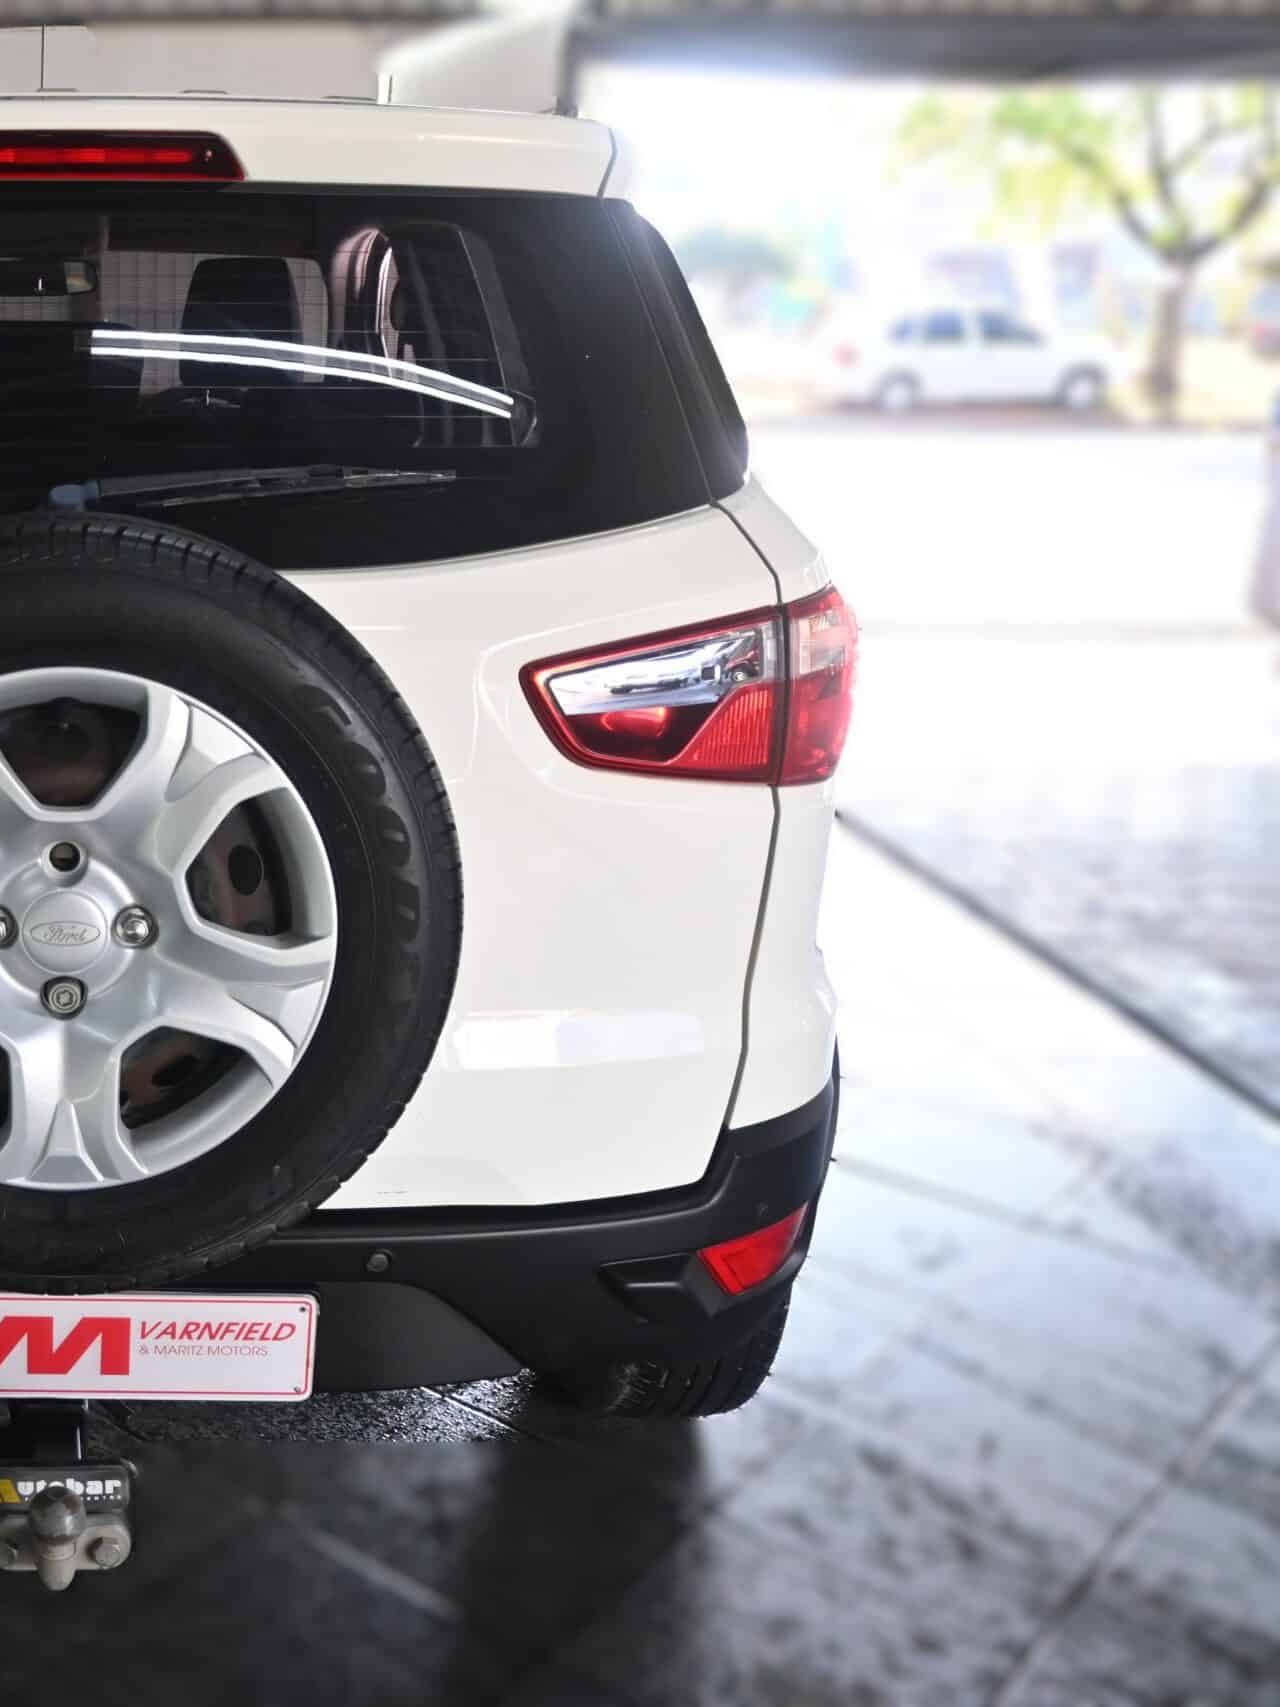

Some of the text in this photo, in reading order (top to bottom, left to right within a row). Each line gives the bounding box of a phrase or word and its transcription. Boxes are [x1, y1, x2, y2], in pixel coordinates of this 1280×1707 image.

[139, 1320, 297, 1341] VARNFIELD
[138, 1345, 269, 1357] & MARITZ MOTORS
